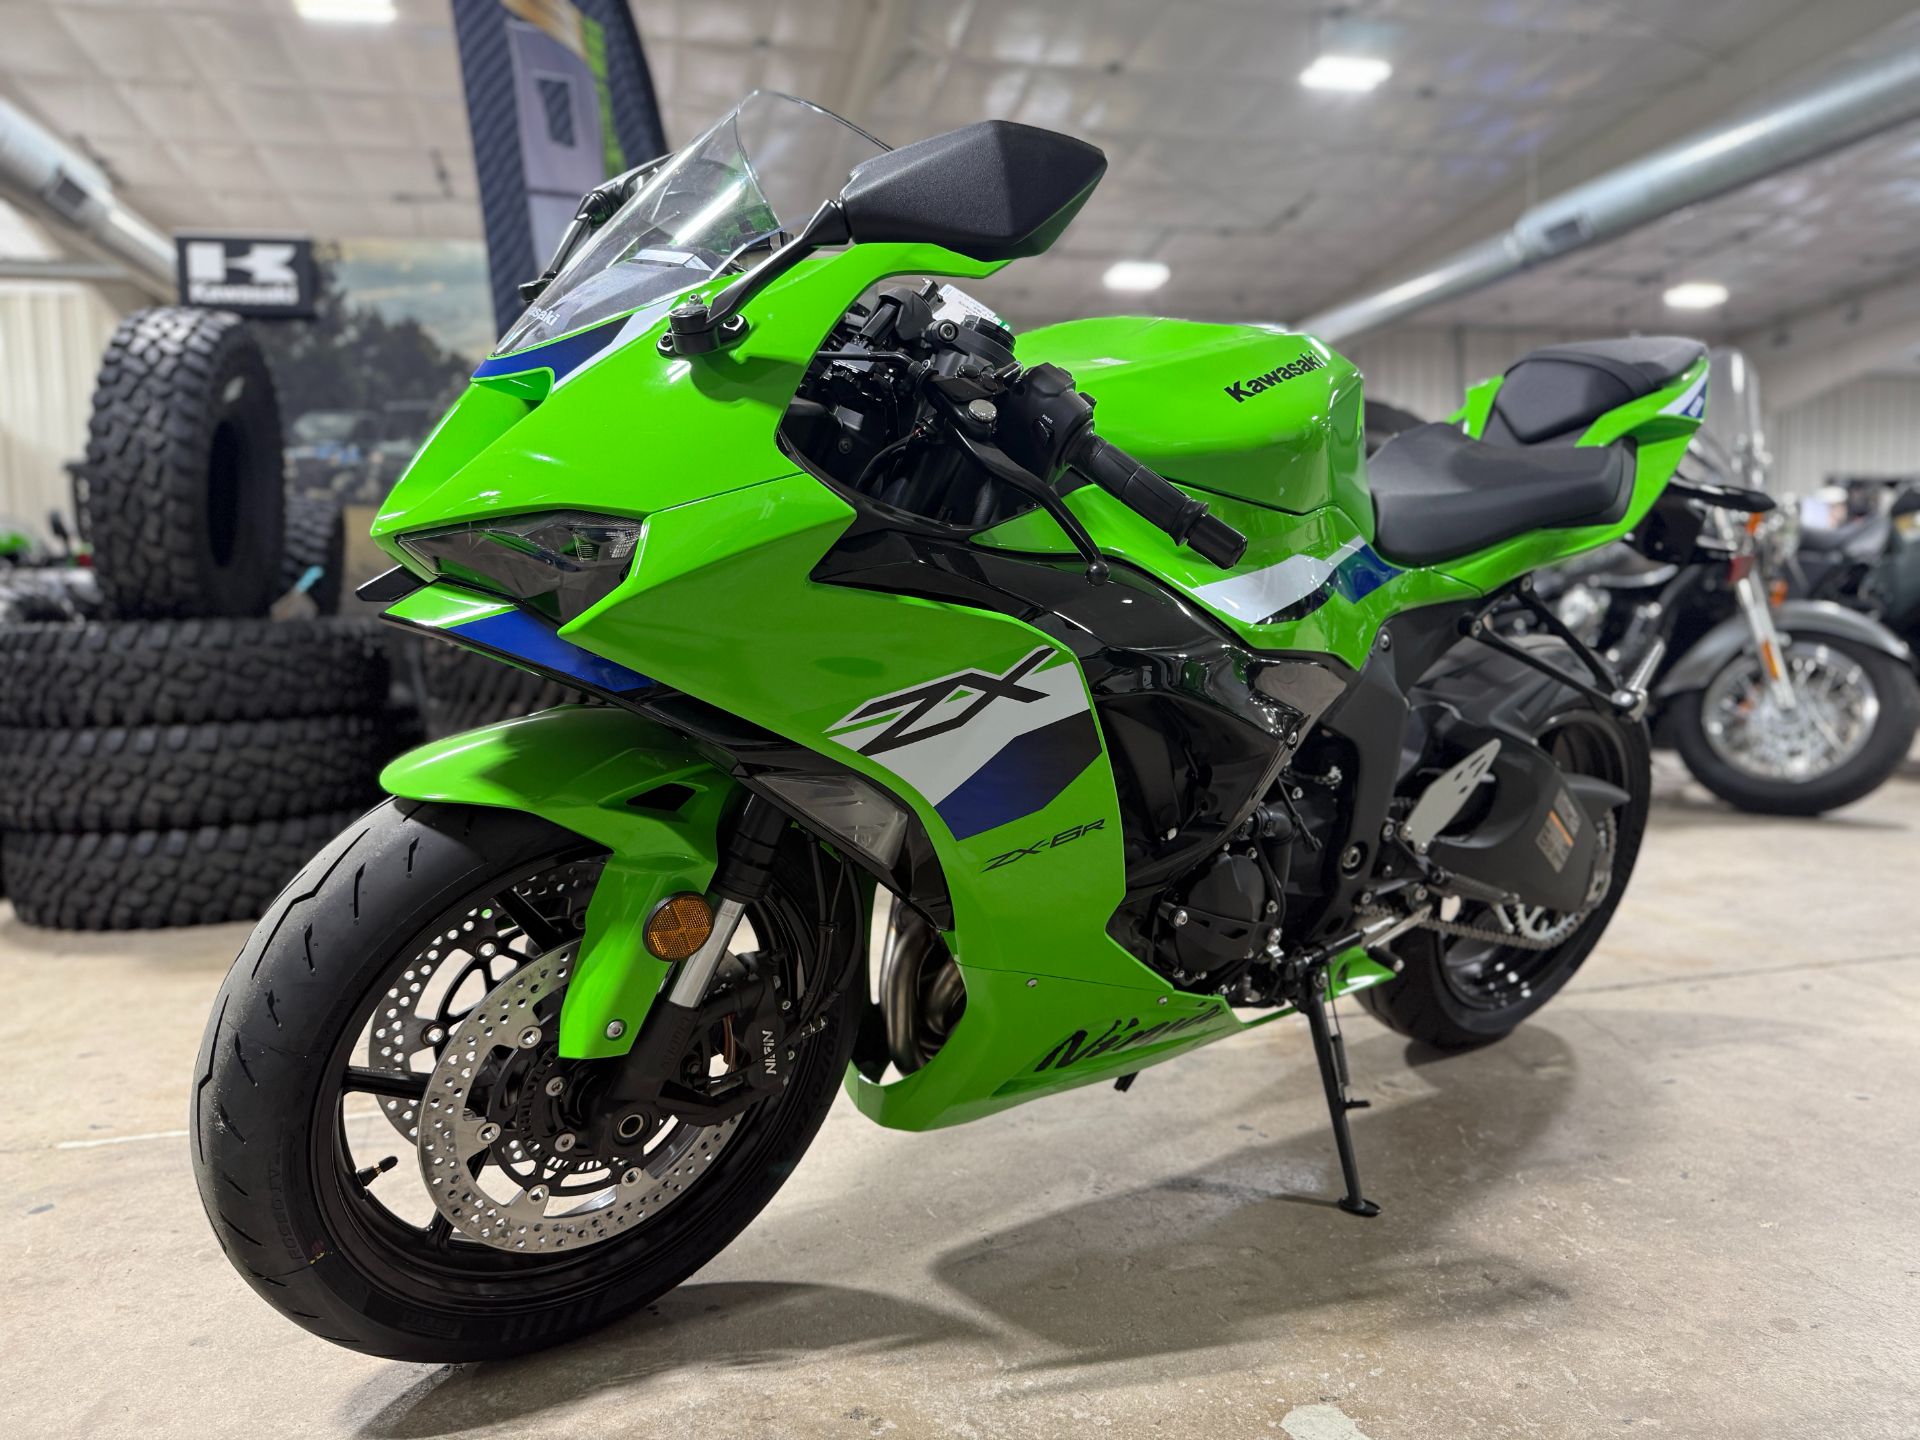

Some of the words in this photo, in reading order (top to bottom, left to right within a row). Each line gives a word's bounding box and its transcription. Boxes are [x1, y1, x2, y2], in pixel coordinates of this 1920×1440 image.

[1223, 350, 1325, 403] Kawasaki
[846, 647, 1057, 757] ZX
[980, 818, 1106, 873] ZX-6R
[1034, 1001, 1224, 1072] Ninja
